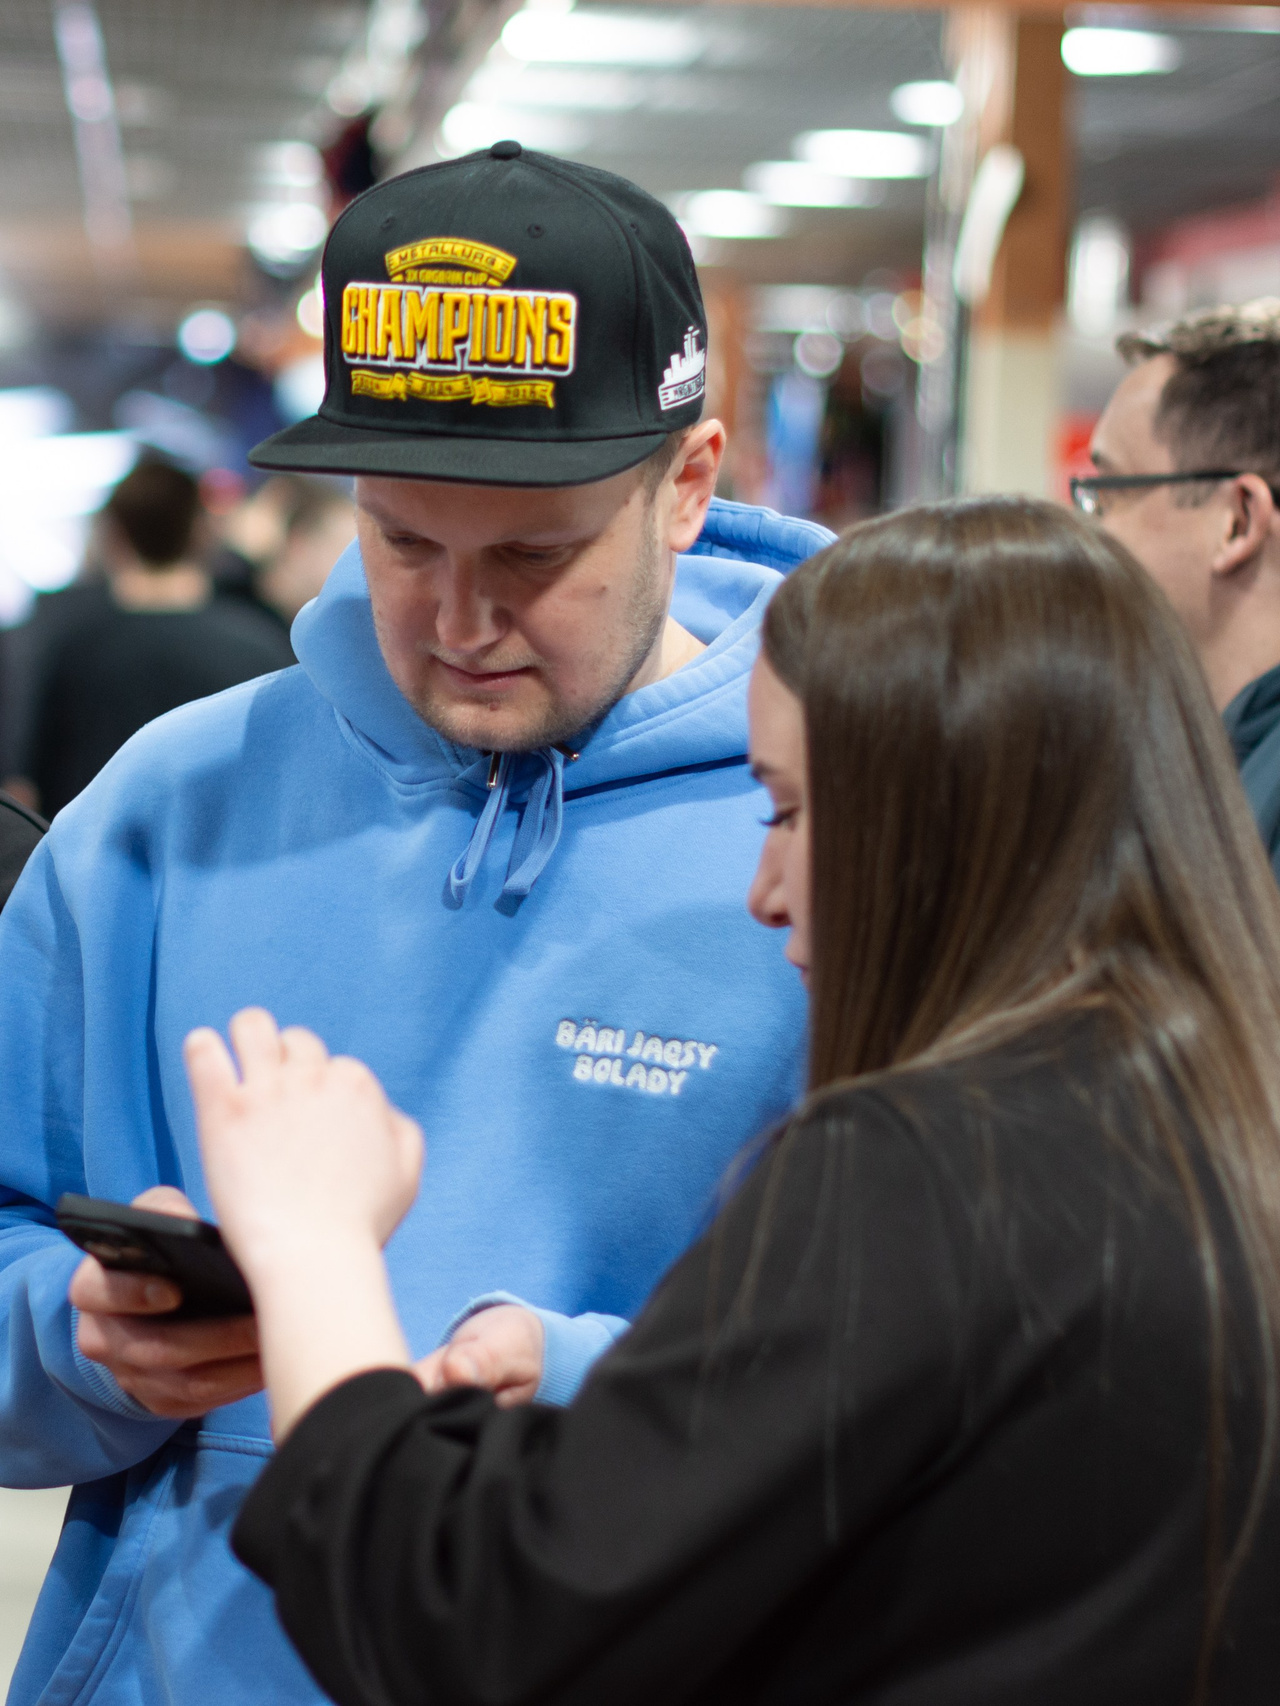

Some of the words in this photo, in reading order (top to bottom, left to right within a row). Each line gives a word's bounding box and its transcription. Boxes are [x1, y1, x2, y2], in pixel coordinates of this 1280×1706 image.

[398, 242, 498, 267] METALLURG
[464, 270, 488, 286] CUP
[341, 286, 573, 366] CHAMPIONS
[573, 1054, 687, 1095] BOLADY
